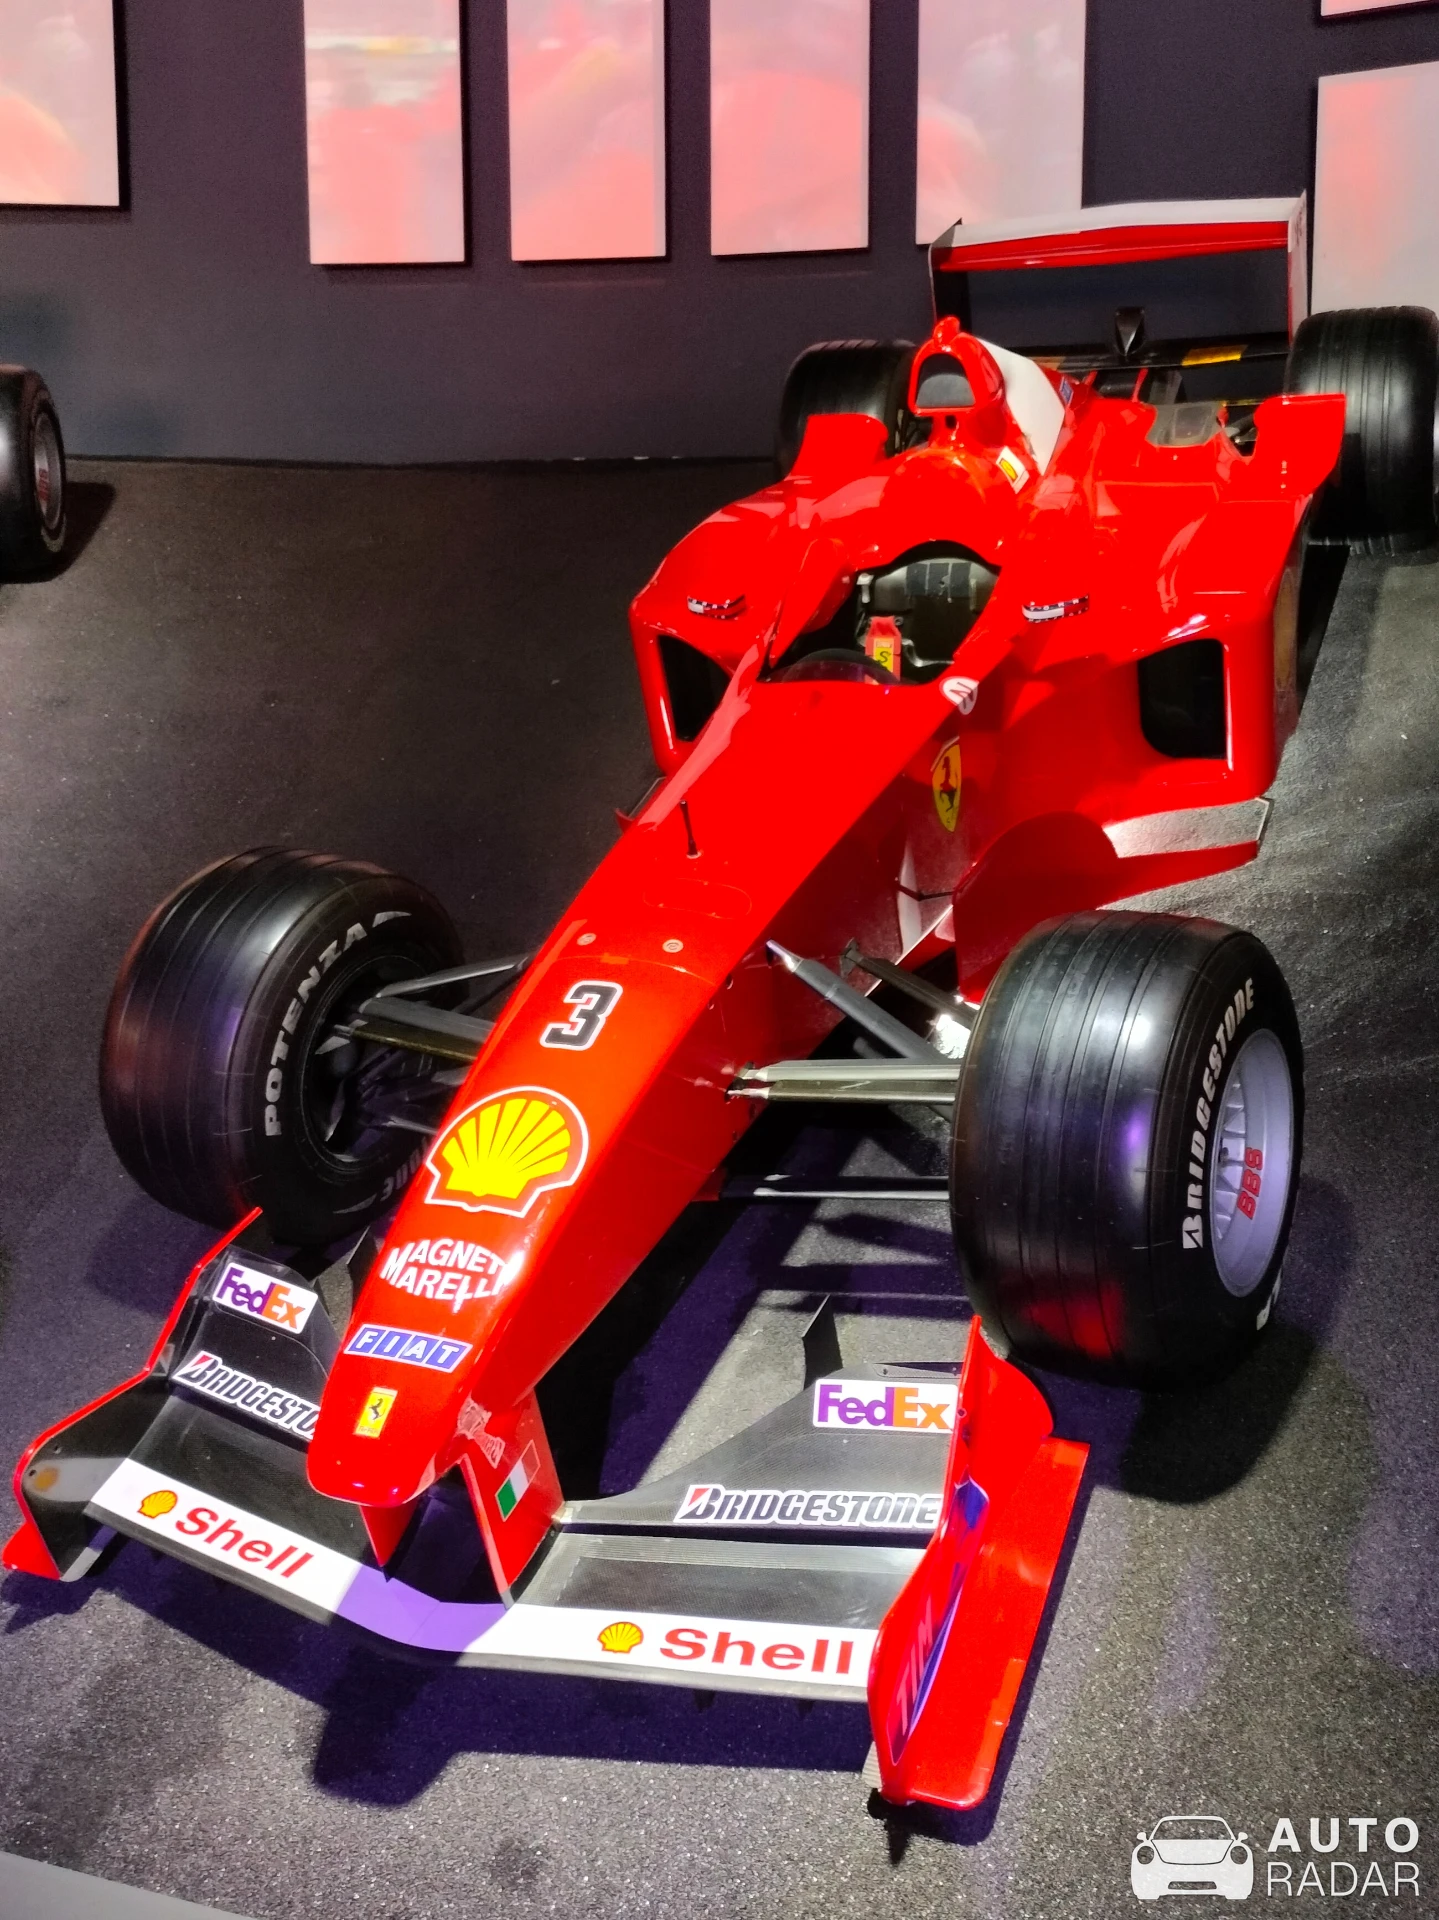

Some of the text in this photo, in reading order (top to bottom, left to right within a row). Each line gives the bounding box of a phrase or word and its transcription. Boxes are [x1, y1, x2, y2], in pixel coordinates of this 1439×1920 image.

[264, 922, 368, 1136] POTENZA
[541, 982, 622, 1049] 3
[1182, 977, 1255, 1249] BRIDGESTONE
[1236, 1147, 1264, 1220] BBS
[215, 1266, 306, 1330] FedEx
[354, 1330, 461, 1365] FIAT
[817, 1383, 950, 1430] FedEx
[679, 1487, 942, 1525] BRIDGESTONE
[175, 1507, 315, 1579] Shell
[659, 1627, 854, 1675] Shell
[895, 1595, 934, 1737] TIM
